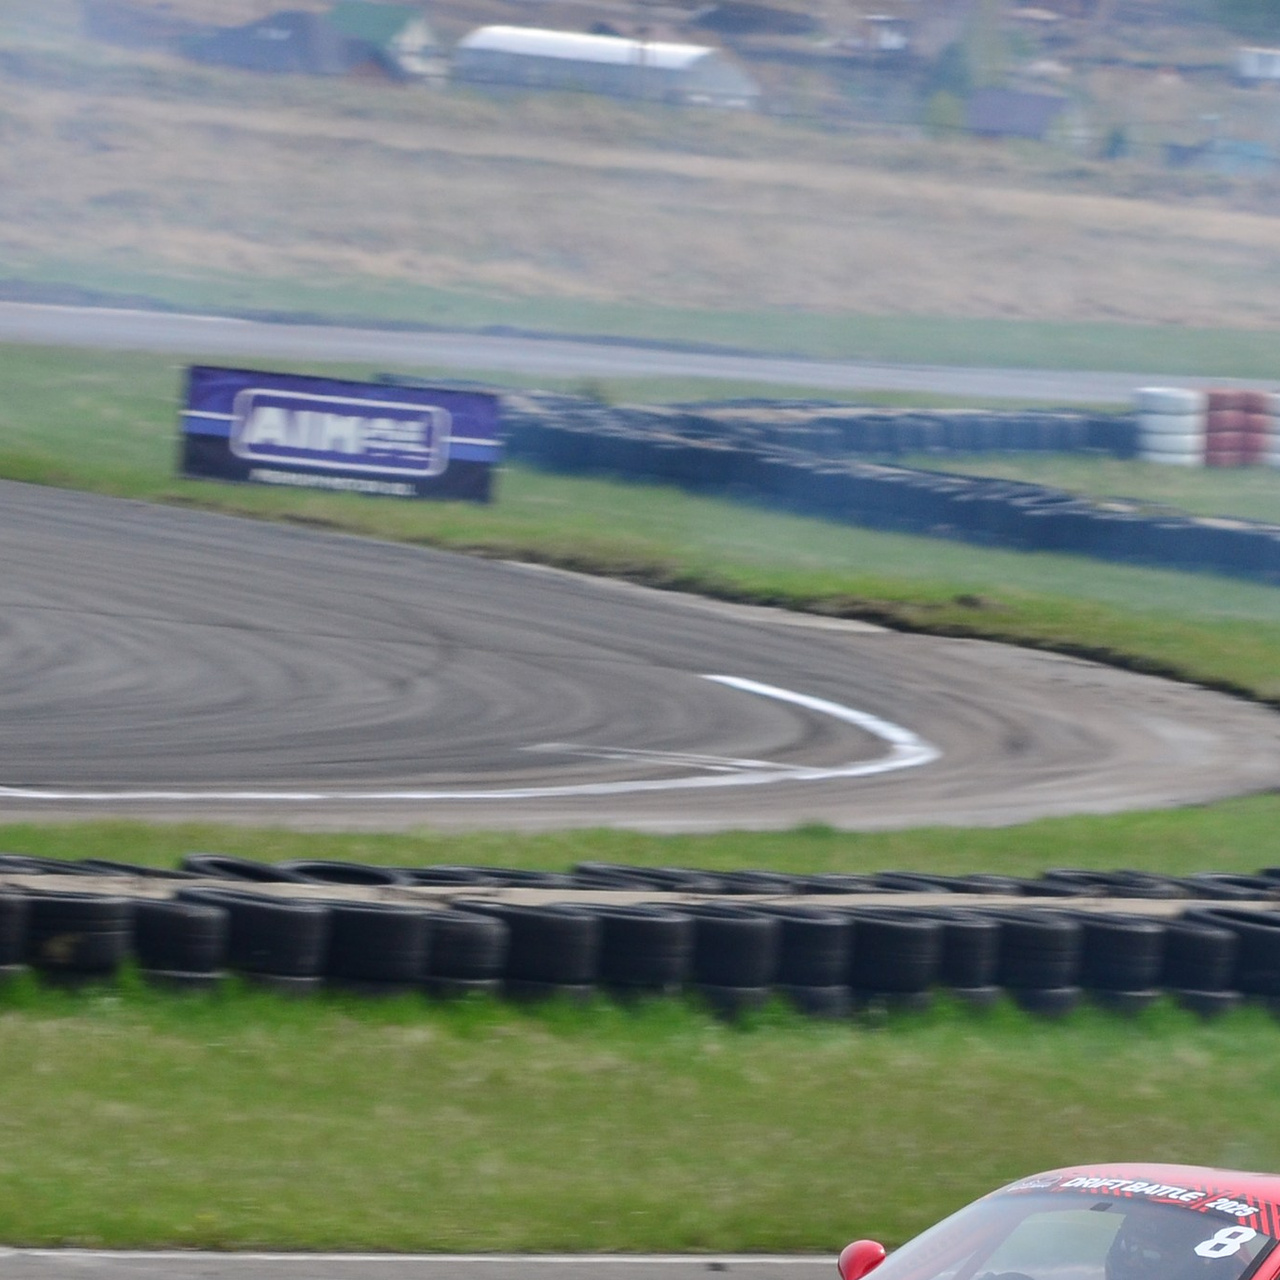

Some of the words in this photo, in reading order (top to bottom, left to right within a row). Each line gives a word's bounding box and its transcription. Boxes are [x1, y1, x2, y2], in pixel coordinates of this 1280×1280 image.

[1060, 1177, 1132, 1189] DRIFT
[1121, 1181, 1205, 1202] BATTLE
[1206, 1198, 1259, 1217] 2025
[1194, 1226, 1257, 1259] 8
